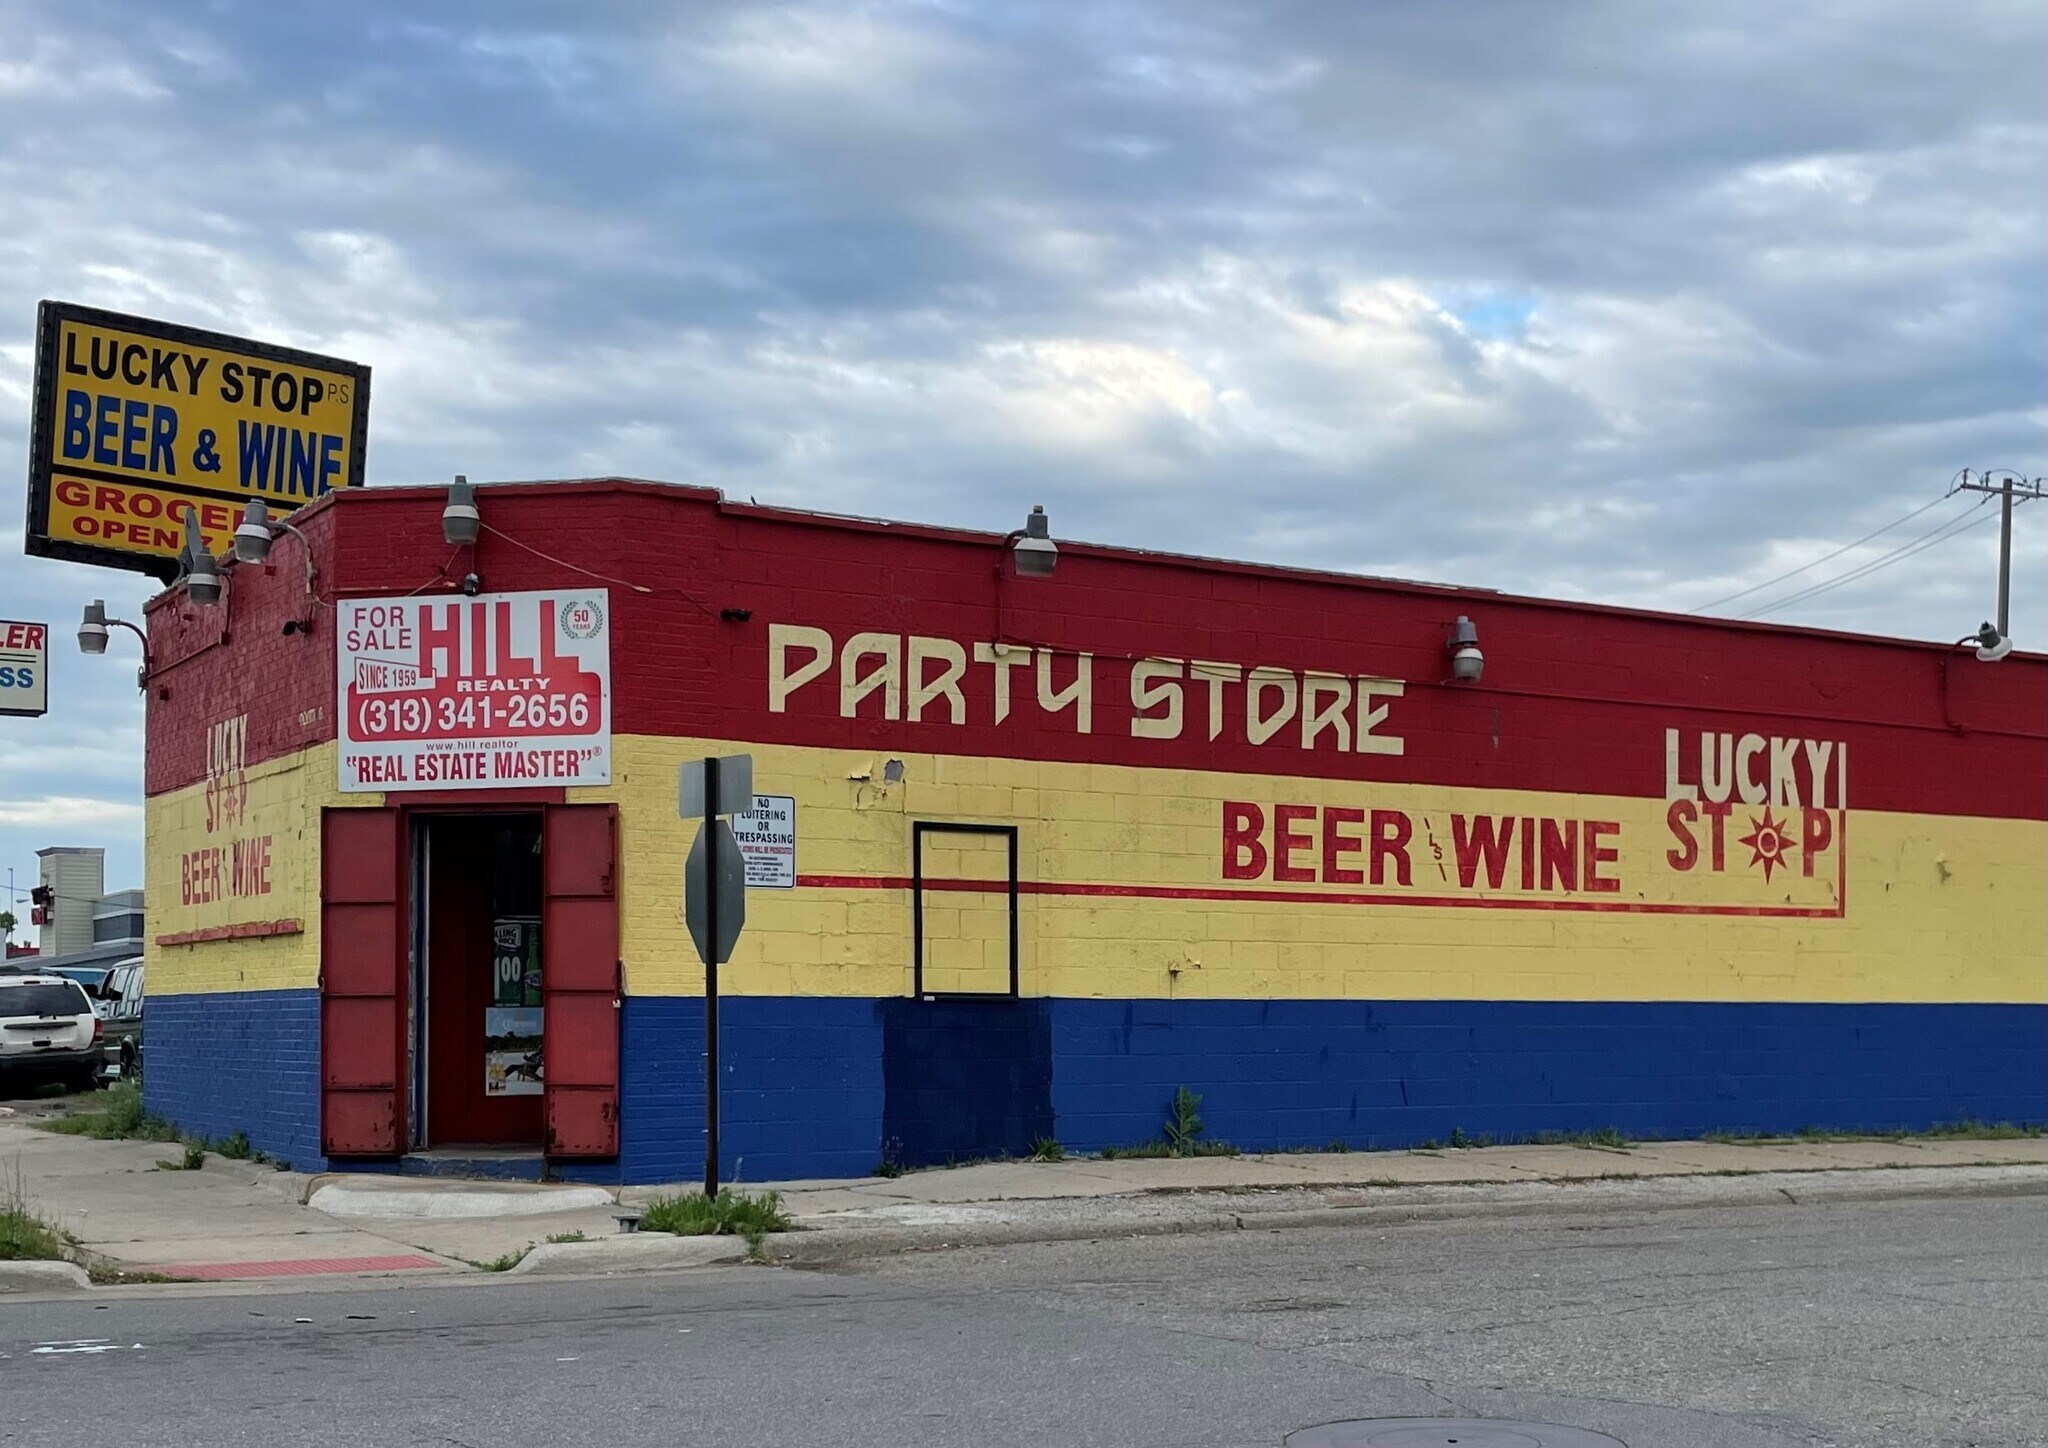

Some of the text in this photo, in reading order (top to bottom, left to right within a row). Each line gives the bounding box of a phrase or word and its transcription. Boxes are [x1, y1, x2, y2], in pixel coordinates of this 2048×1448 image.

[65, 332, 209, 396] LUCKY
[220, 362, 324, 416] STOP
[62, 389, 344, 498] BEER & WINE
[72, 516, 181, 550] OPEN
[354, 606, 405, 628] FOR
[573, 609, 589, 623] 50
[0, 625, 44, 650] ER
[346, 628, 412, 652] SALE
[419, 600, 579, 679] HILL
[358, 662, 417, 690] SINCE 1959
[457, 678, 551, 692] REALTY
[768, 623, 1406, 756] PARTY STORE
[359, 697, 432, 736] (313)
[438, 692, 589, 730] 341-2656
[206, 713, 248, 781] LUCKY
[426, 739, 519, 751] www.hill.realtor
[414, 751, 487, 782] ESTATE
[741, 809, 786, 821] LOITERING
[757, 798, 770, 808] NO
[734, 831, 793, 844] TRESPASSING
[757, 821, 770, 831] OR
[1221, 800, 1413, 888] BEER
[1449, 812, 1621, 893] WINE
[181, 835, 273, 906] BEER WINE
